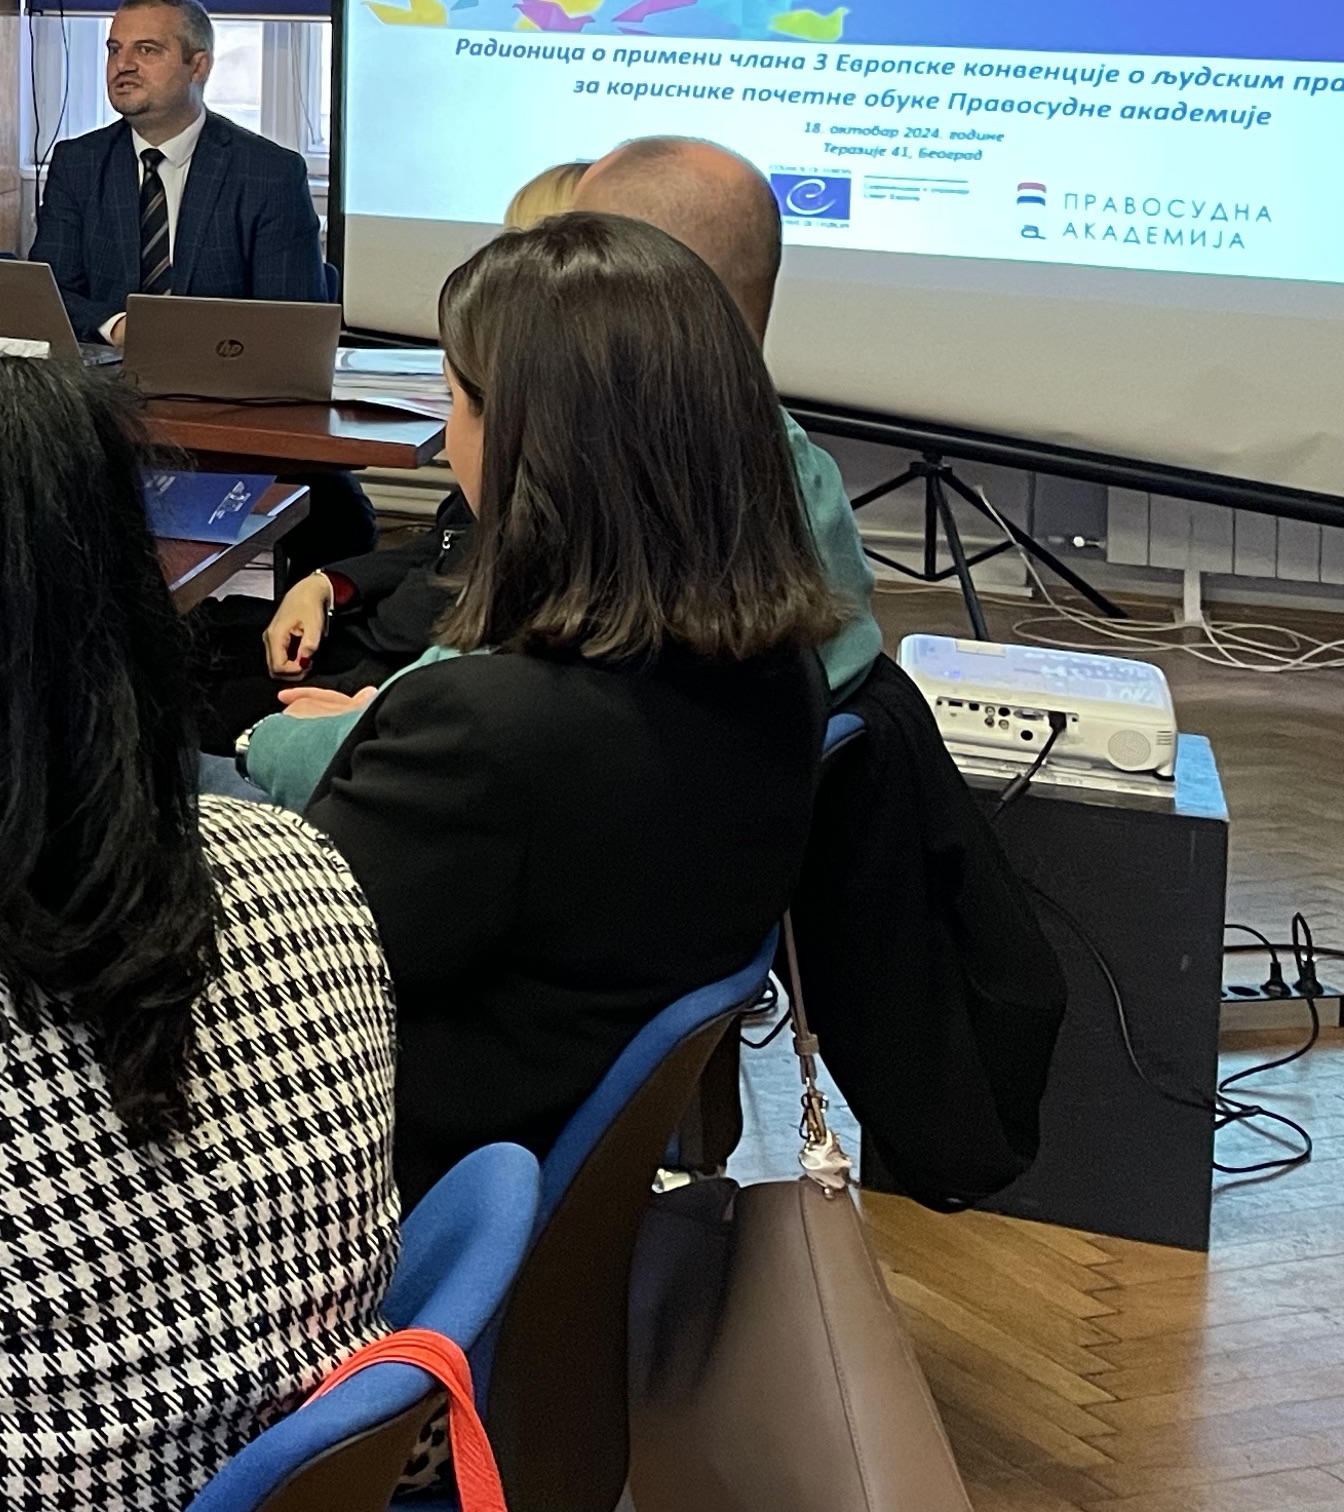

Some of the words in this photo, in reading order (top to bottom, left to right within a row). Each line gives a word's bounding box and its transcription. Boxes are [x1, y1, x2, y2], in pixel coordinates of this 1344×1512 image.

[455, 38, 585, 62] Радионица
[591, 48, 606, 63] о
[613, 49, 722, 69] примени
[730, 52, 805, 71] члана
[813, 53, 827, 71] 3
[836, 54, 955, 80] Европске
[964, 60, 1120, 86] конвенције
[1129, 69, 1145, 84] о
[1152, 66, 1284, 90] људским
[573, 79, 599, 94] за
[607, 81, 734, 101] кориснике
[743, 87, 856, 107] почетне
[865, 91, 940, 114] обуке
[948, 93, 1112, 120] Правосудне
[1120, 102, 1272, 130] академије
[1064, 193, 1273, 223] ПРАВОСУДНА
[1063, 222, 1246, 250] АКАДЕМИЈА
